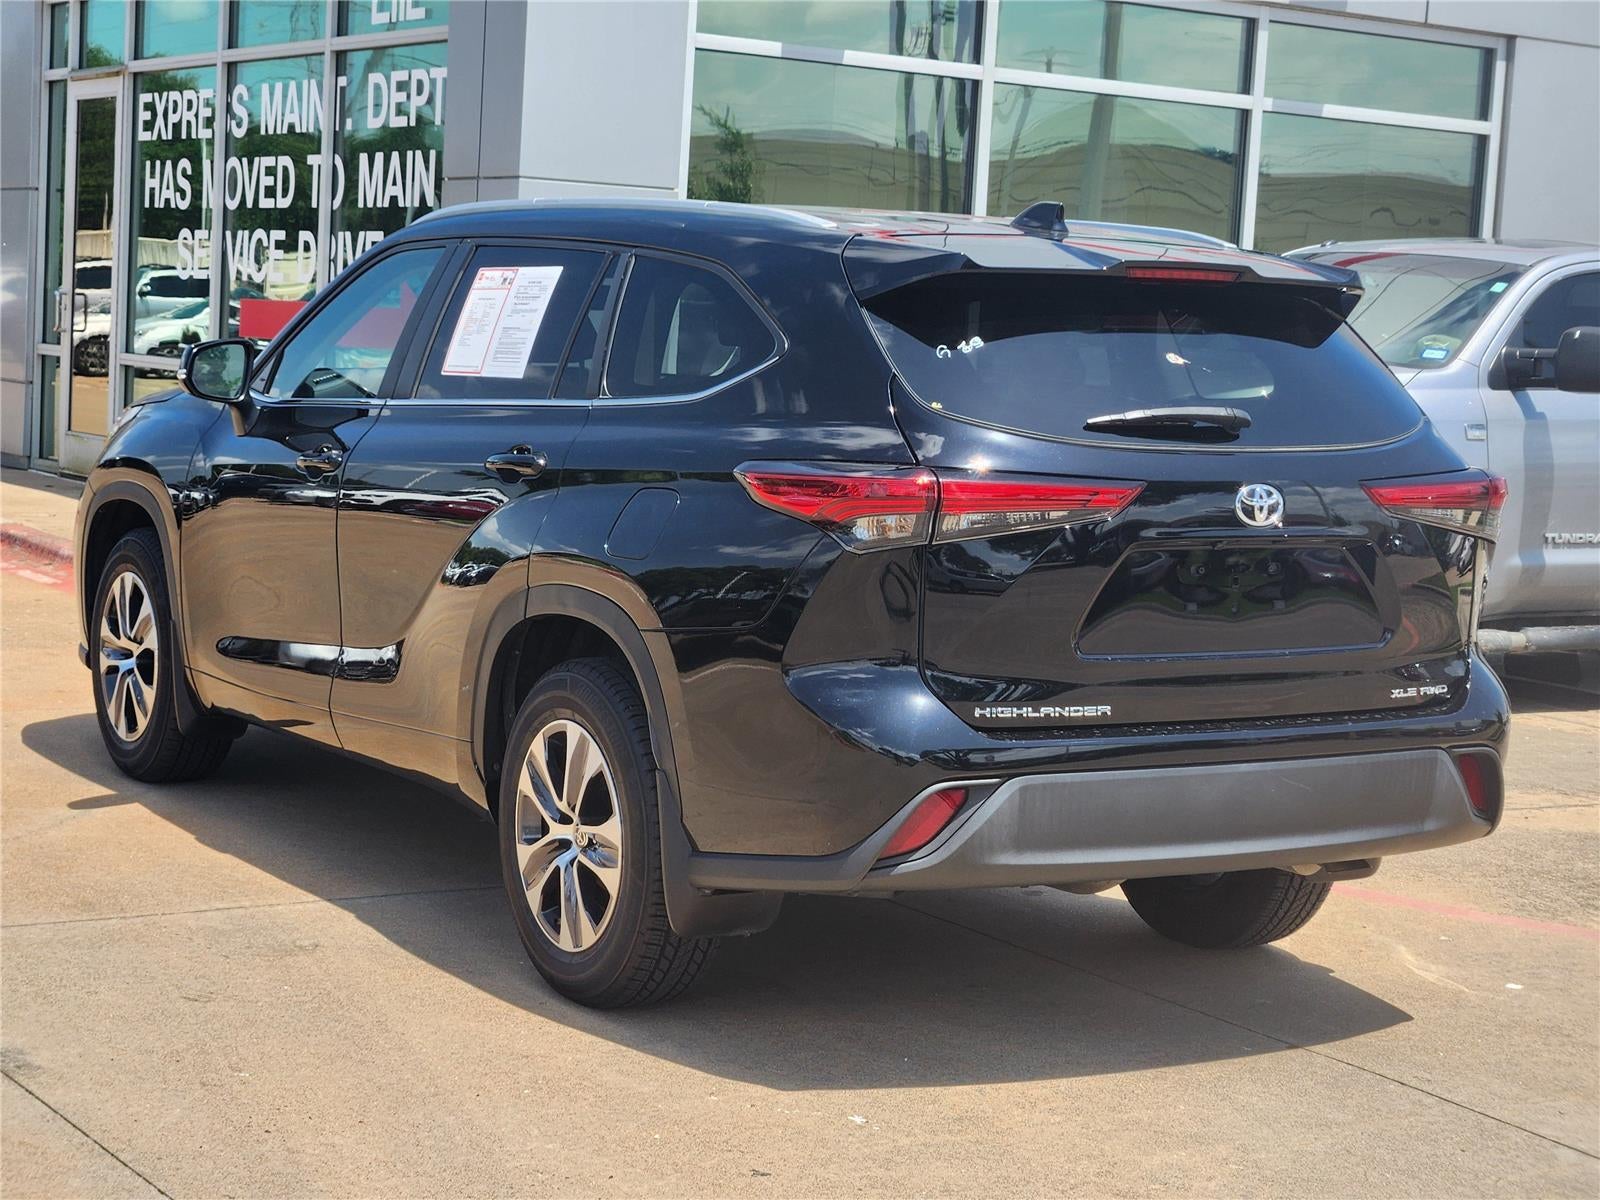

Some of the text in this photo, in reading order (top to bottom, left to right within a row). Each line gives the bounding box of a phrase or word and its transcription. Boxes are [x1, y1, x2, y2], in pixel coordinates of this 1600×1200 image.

[137, 83, 249, 141] EXPRES
[367, 67, 448, 129] DEPT
[144, 157, 193, 210] HAS
[357, 149, 436, 209] MAIN
[176, 227, 287, 284] SEVICE
[974, 705, 1112, 718] HIGHLANDER
[1390, 687, 1417, 699] XLE
